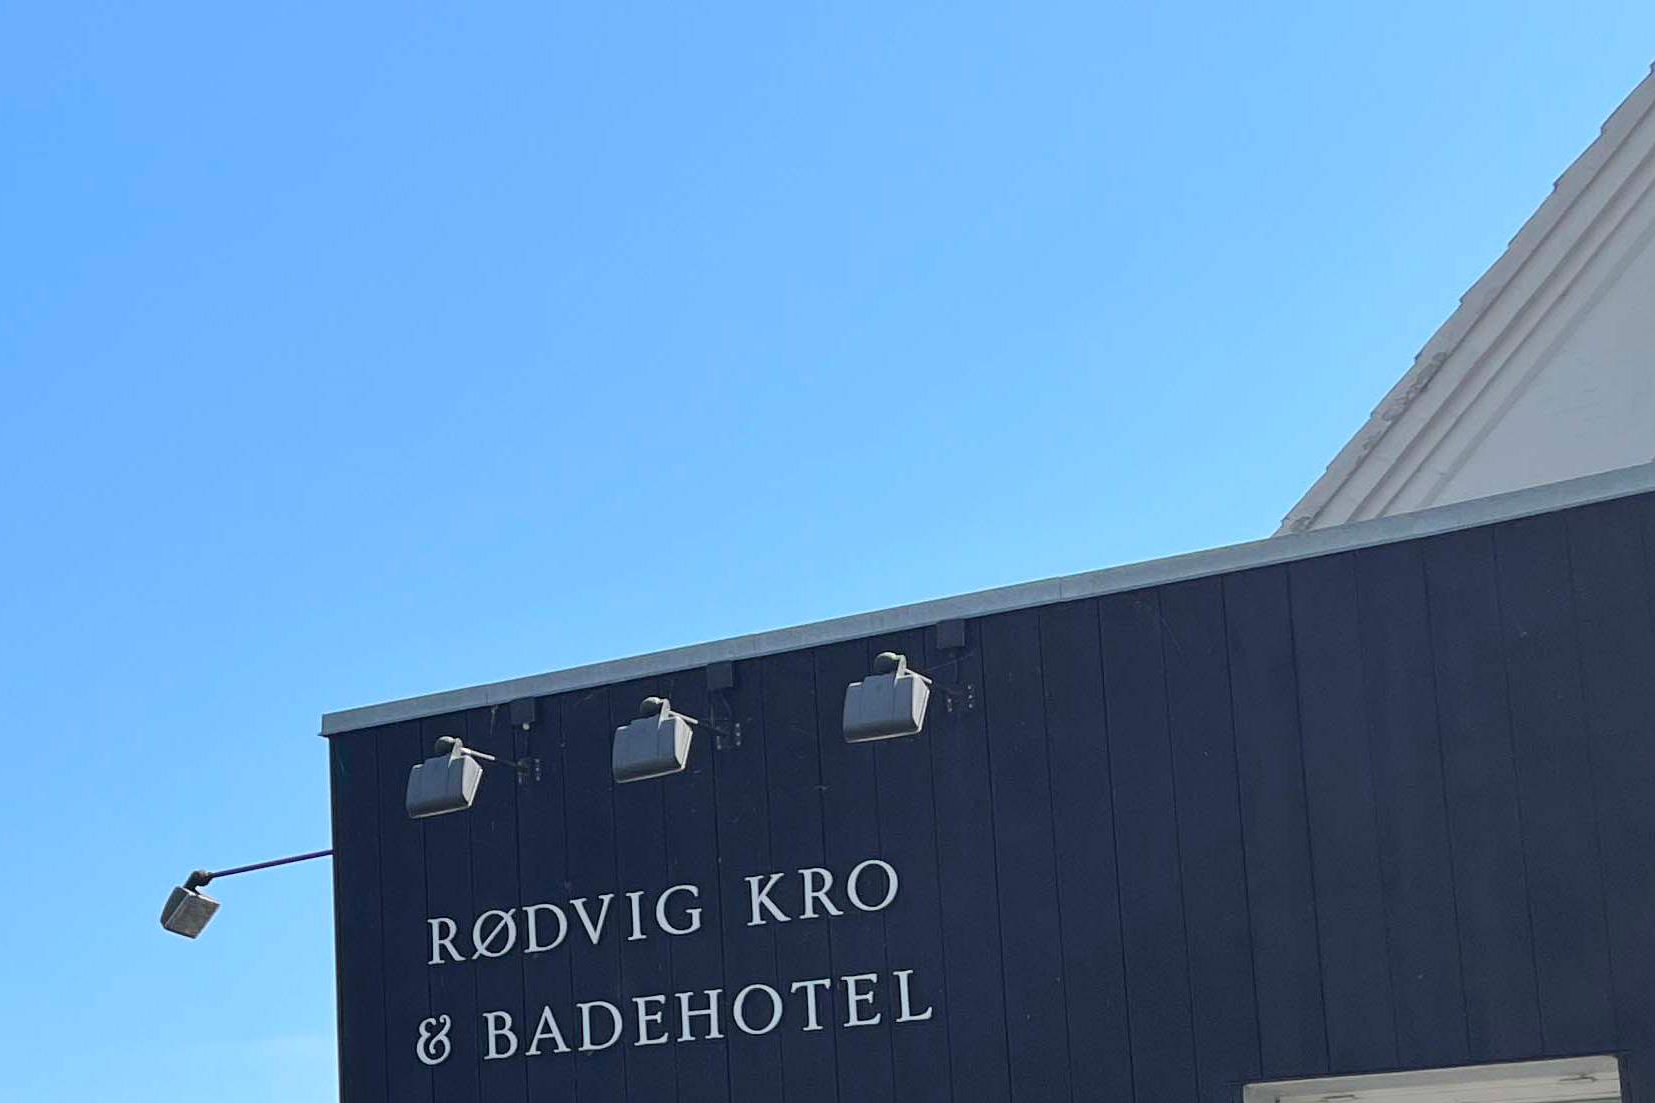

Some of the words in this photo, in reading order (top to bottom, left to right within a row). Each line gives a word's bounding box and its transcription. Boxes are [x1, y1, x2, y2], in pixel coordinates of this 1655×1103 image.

[427, 884, 703, 965] RØDVIG
[745, 859, 899, 926] KRO
[416, 1014, 452, 1065] &
[483, 969, 933, 1060] BADEHOTEL
